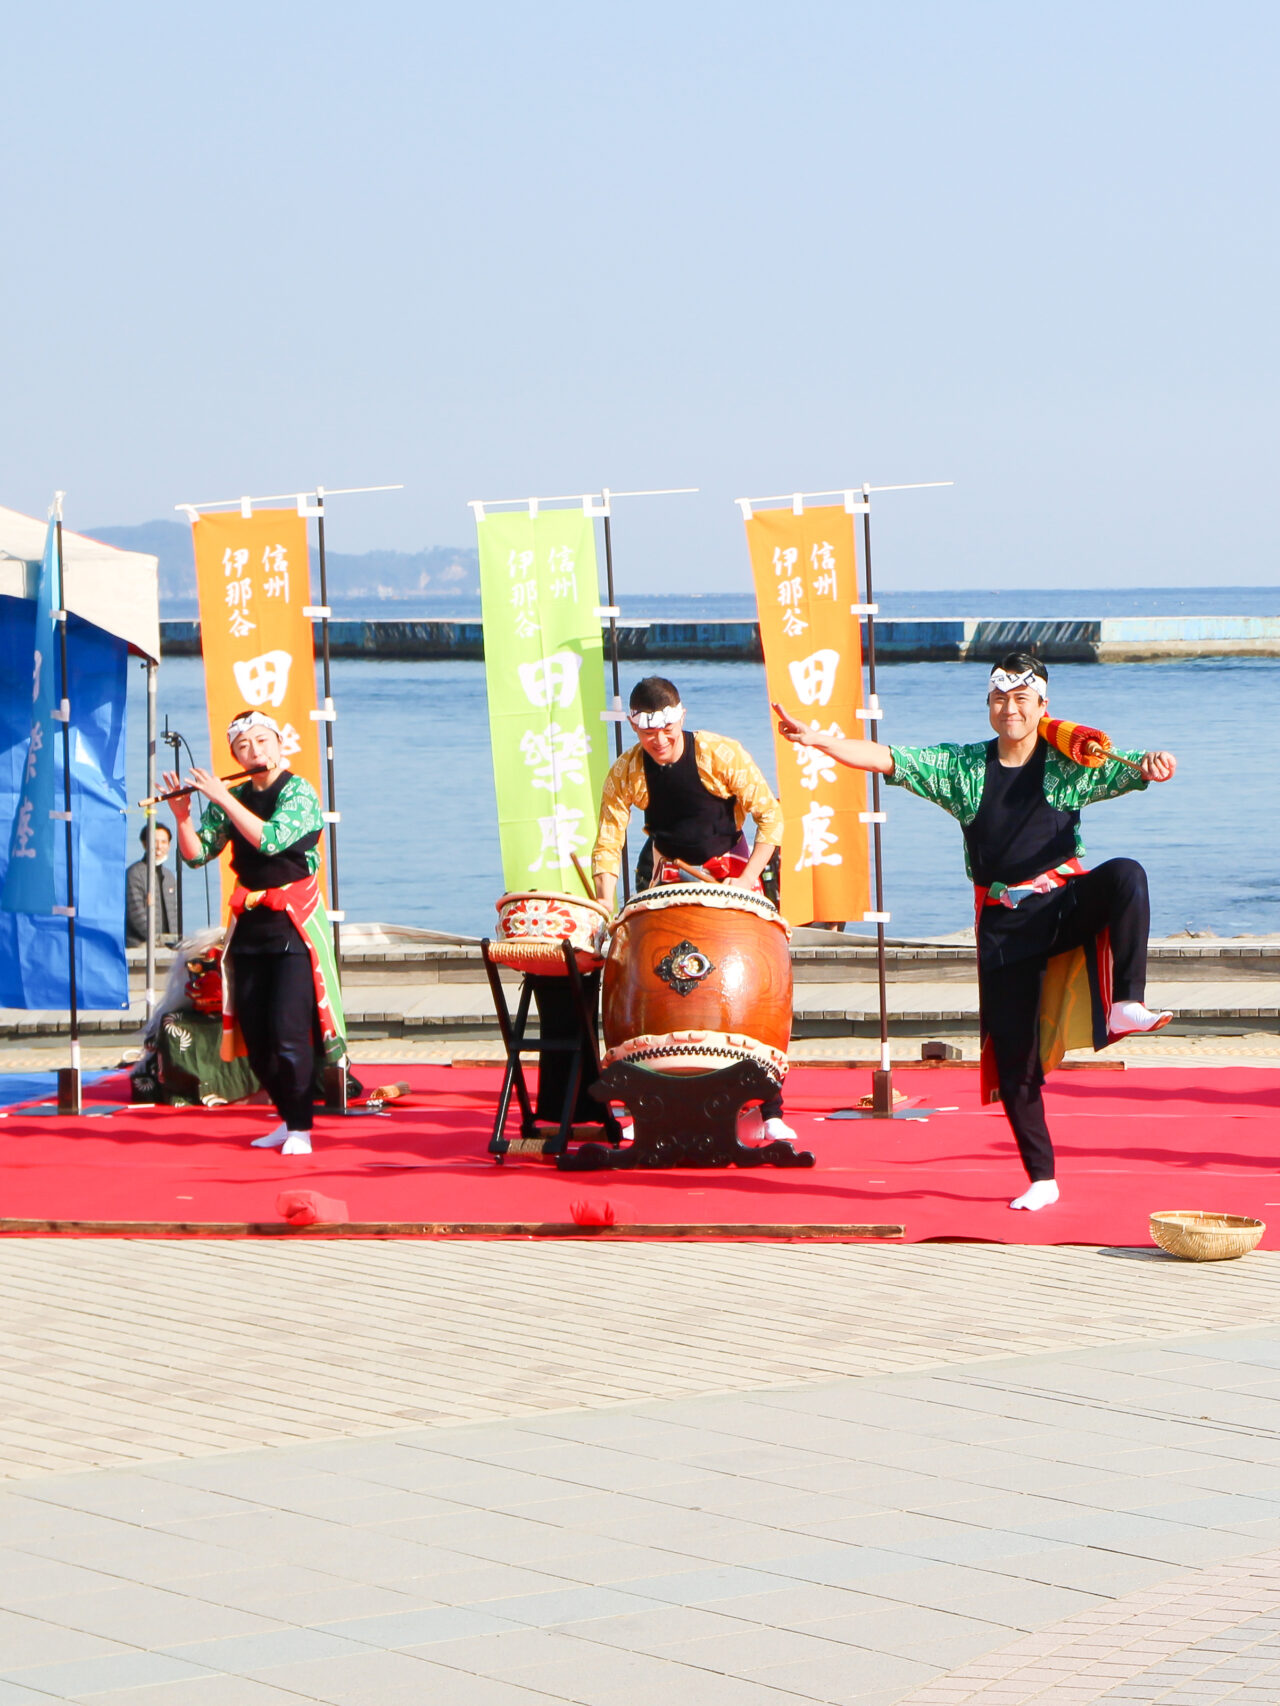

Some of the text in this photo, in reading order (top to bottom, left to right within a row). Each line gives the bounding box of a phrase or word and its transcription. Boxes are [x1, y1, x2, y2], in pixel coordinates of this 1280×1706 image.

[222, 546, 257, 638] 伊那谷
[261, 543, 290, 605] 信州
[506, 548, 542, 639] 伊那谷
[547, 544, 579, 604] 信州
[771, 545, 809, 637] 伊那谷
[810, 540, 838, 602] 信州
[517, 650, 595, 873] 田樂座
